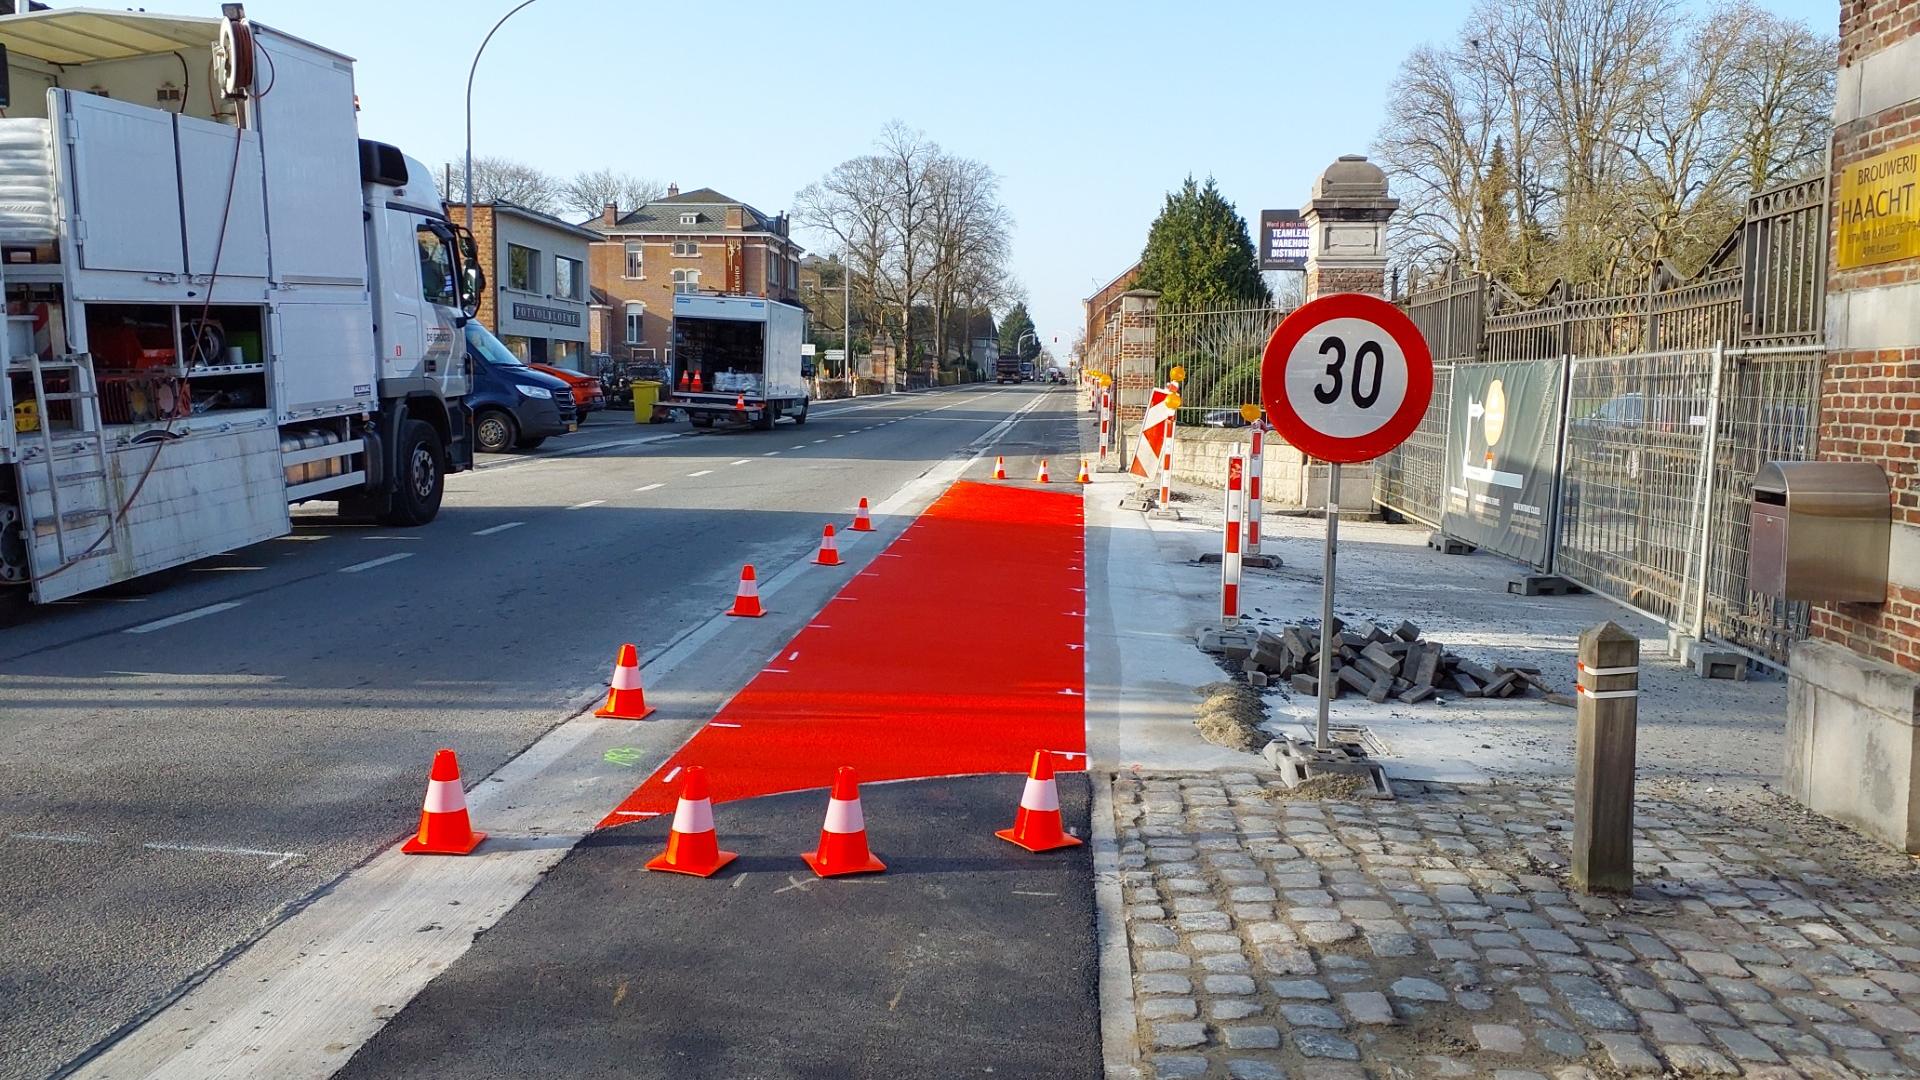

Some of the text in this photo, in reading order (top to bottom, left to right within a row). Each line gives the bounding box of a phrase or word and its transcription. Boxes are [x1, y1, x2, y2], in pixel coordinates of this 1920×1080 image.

[1857, 154, 1918, 186] BROUWERIJ
[1841, 183, 1915, 226] HAACHT
[1314, 336, 1384, 409] 30
